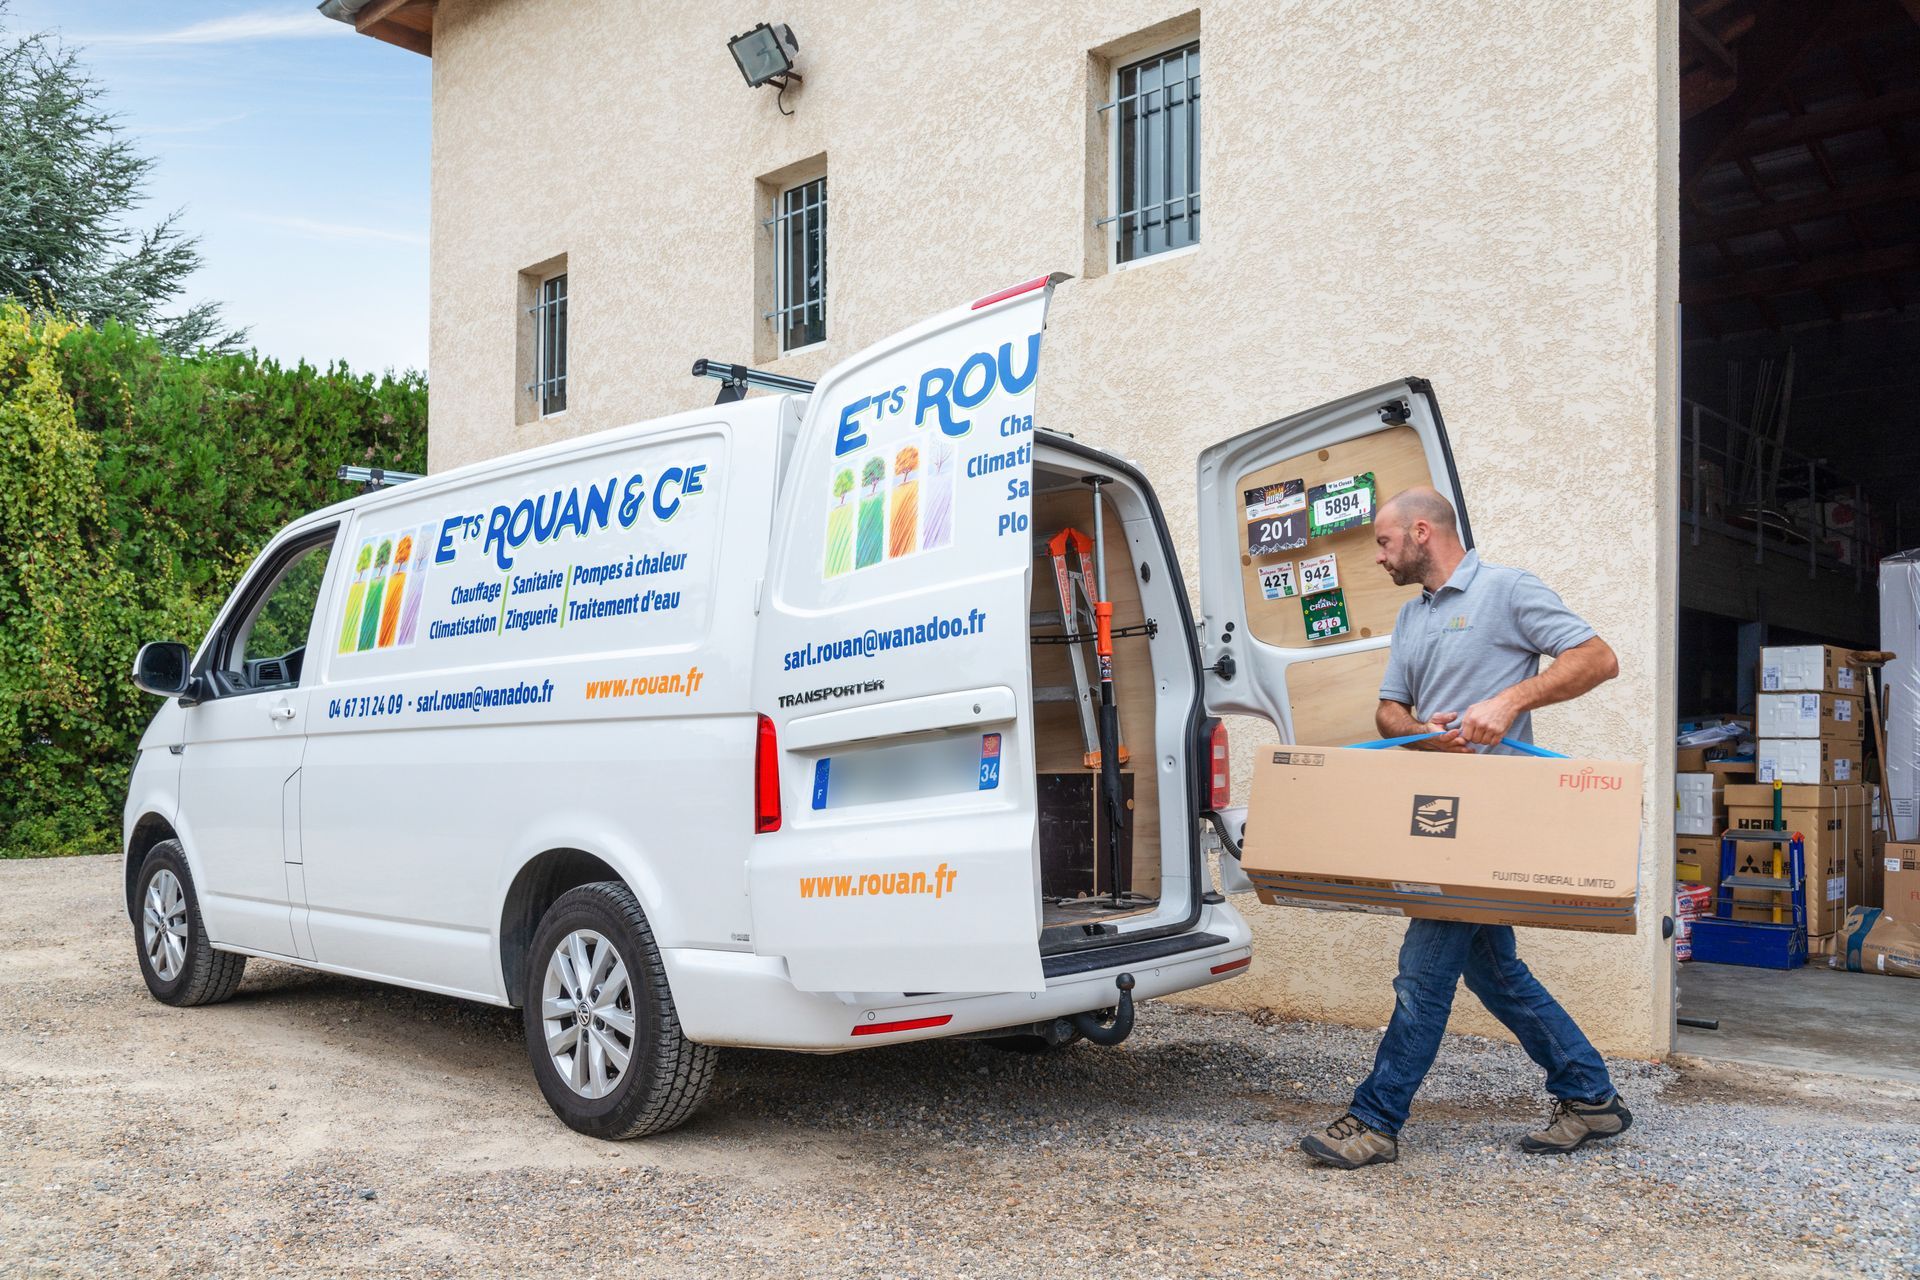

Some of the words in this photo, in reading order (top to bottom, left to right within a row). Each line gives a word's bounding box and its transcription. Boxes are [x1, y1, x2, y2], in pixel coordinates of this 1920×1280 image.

[915, 332, 1041, 436] ROU
[1000, 413, 1033, 437] Cha
[967, 442, 1032, 478] Climati
[1007, 479, 1030, 500] Sa
[1325, 493, 1360, 516] 5894
[484, 477, 617, 570] ROUAN
[618, 474, 645, 528] &
[998, 512, 1028, 536] Plo
[1260, 518, 1292, 542] 201
[572, 562, 624, 586] Pompes
[624, 554, 634, 578] à
[635, 551, 688, 576] chaleur
[1264, 573, 1289, 588] 427
[1304, 565, 1331, 582] 942
[451, 581, 502, 605] Chauffage
[511, 569, 564, 595] Sanitaire
[505, 604, 558, 631] Zinguerie
[569, 593, 639, 621] Traitement
[429, 613, 497, 640] Climatisation
[1317, 617, 1338, 630] 216
[784, 608, 986, 671] sarl.rouan@wanadoo.fr
[586, 667, 703, 700] www.rouan.fr
[778, 678, 885, 708] TRANSPORTER
[329, 700, 341, 719] 04
[343, 697, 357, 717] 67
[358, 697, 370, 717] 31
[371, 695, 385, 716] 24
[387, 693, 403, 715] 09
[416, 678, 554, 712] sarl.rouan@wanadoo.fr
[981, 762, 997, 783] 34
[1559, 767, 1622, 792] FUJITSU
[817, 789, 823, 799] F
[800, 863, 957, 898] www.rouan.fr
[1492, 871, 1529, 883] FUJITSU
[1533, 874, 1575, 887] GENERAL
[1578, 878, 1616, 889] LIMITED
